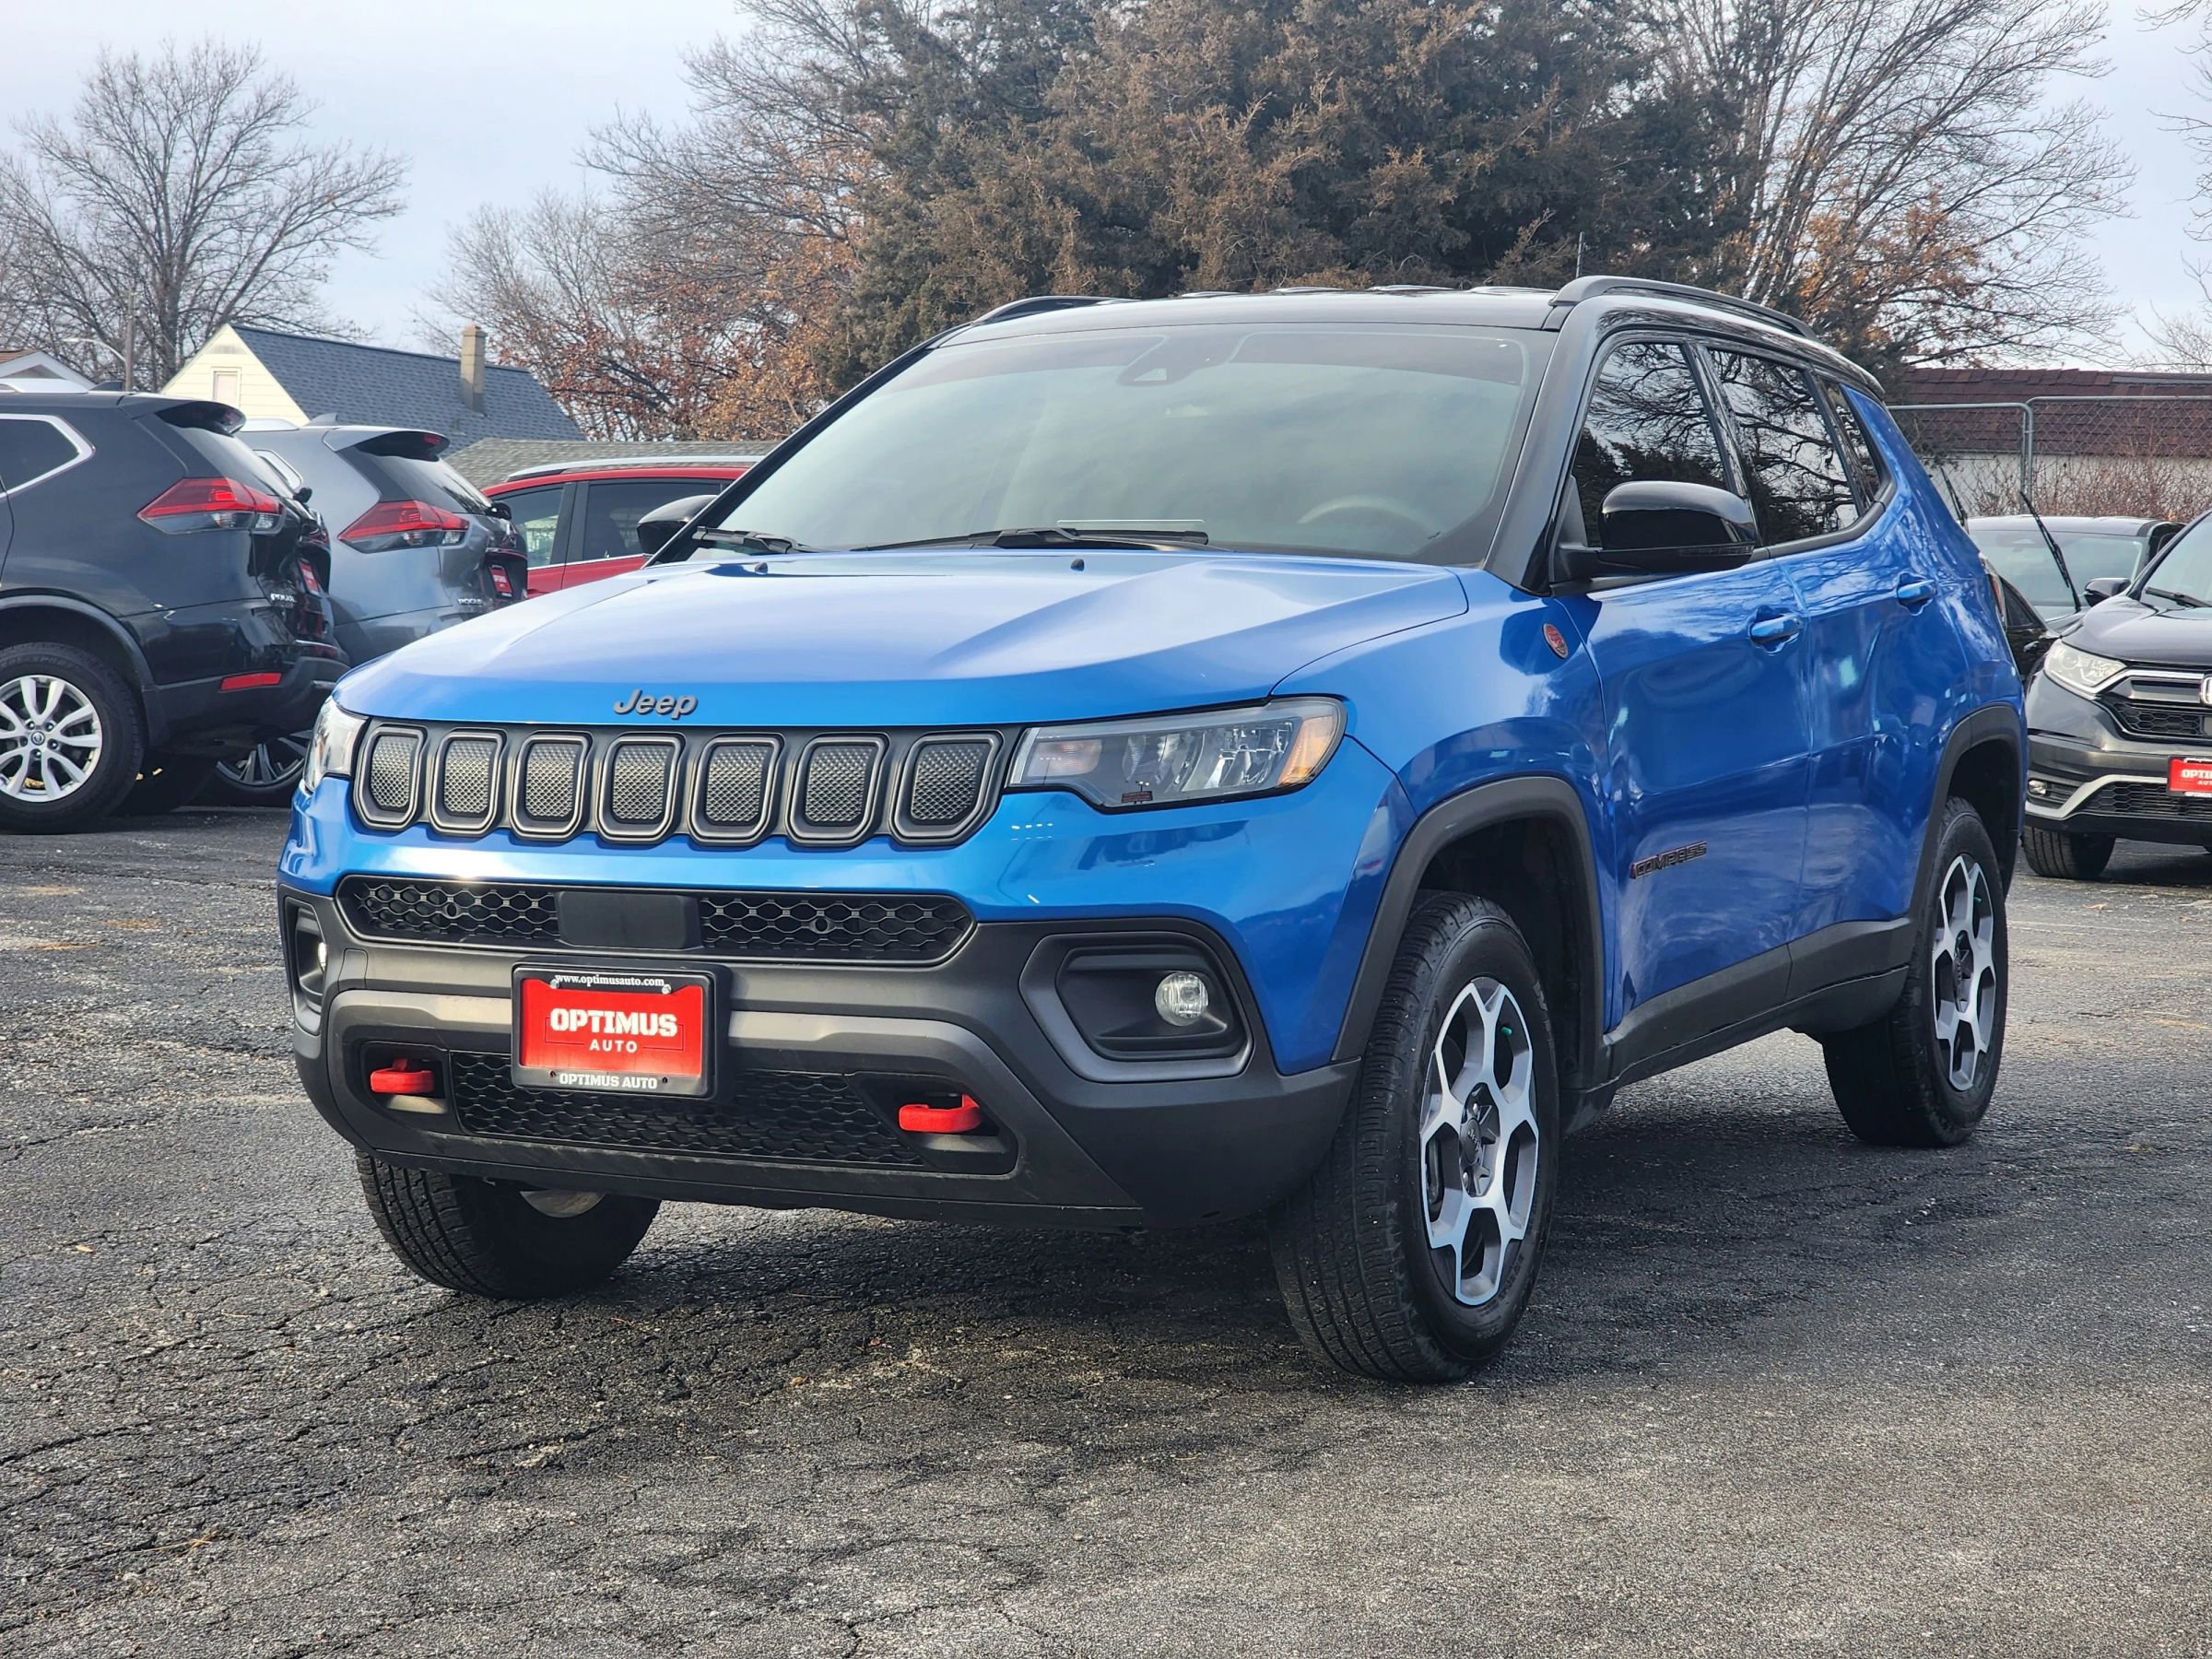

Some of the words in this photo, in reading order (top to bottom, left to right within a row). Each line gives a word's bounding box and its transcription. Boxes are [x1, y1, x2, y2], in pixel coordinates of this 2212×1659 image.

[613, 688, 698, 720] Jeep
[2182, 769, 2212, 780] OPTI
[1630, 841, 1707, 878] COMPASS
[554, 974, 665, 987] www.optimusauto.com
[550, 1008, 677, 1037] OPTIMUS
[589, 1039, 638, 1053] AUTO
[559, 1073, 619, 1087] OPTIMUS
[622, 1077, 657, 1089] AUTO
